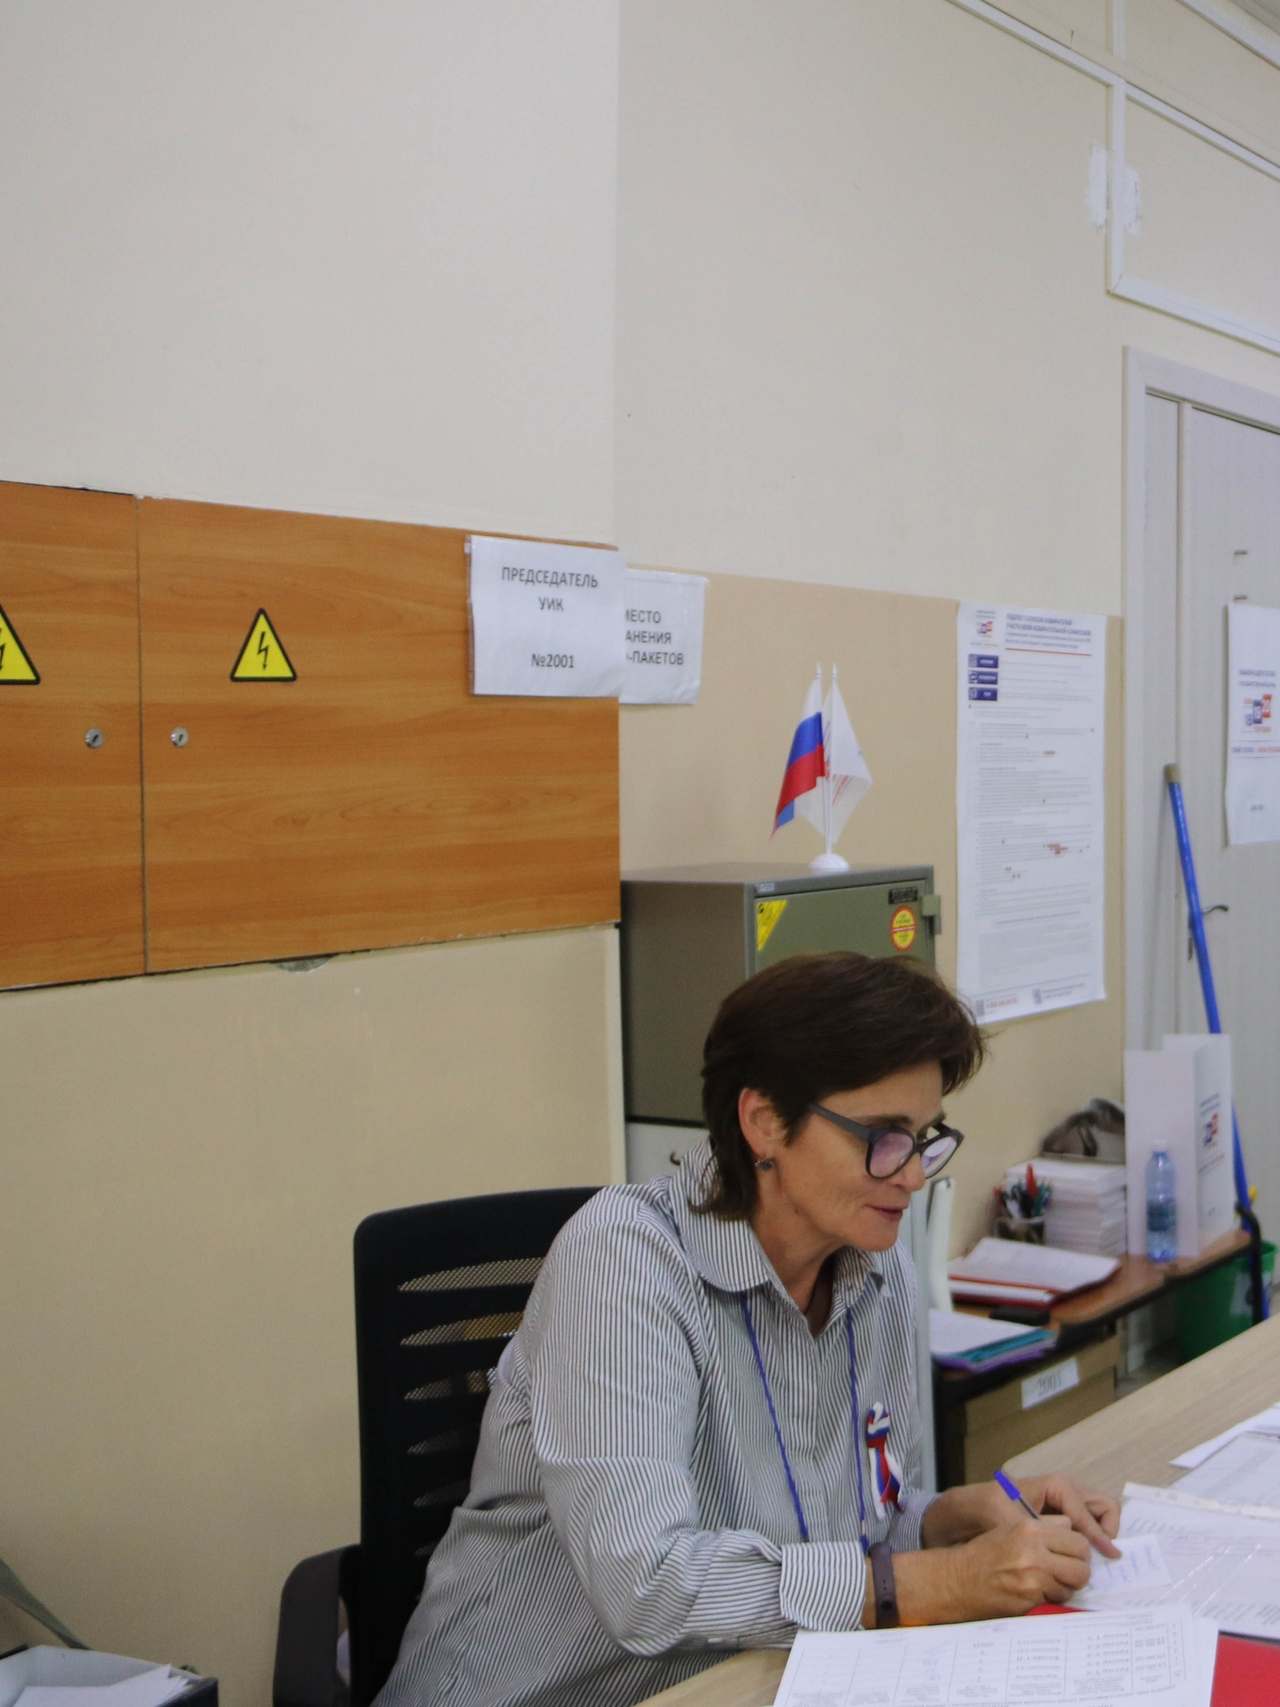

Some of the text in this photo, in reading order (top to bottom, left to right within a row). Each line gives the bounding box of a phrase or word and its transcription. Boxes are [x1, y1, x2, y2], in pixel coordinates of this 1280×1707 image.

[501, 566, 599, 588] ПРЕДСЕДАТЕЛЬ
[538, 596, 564, 612] УИК
[625, 630, 672, 645] АНЕНИЯ
[531, 653, 575, 669] №2001
